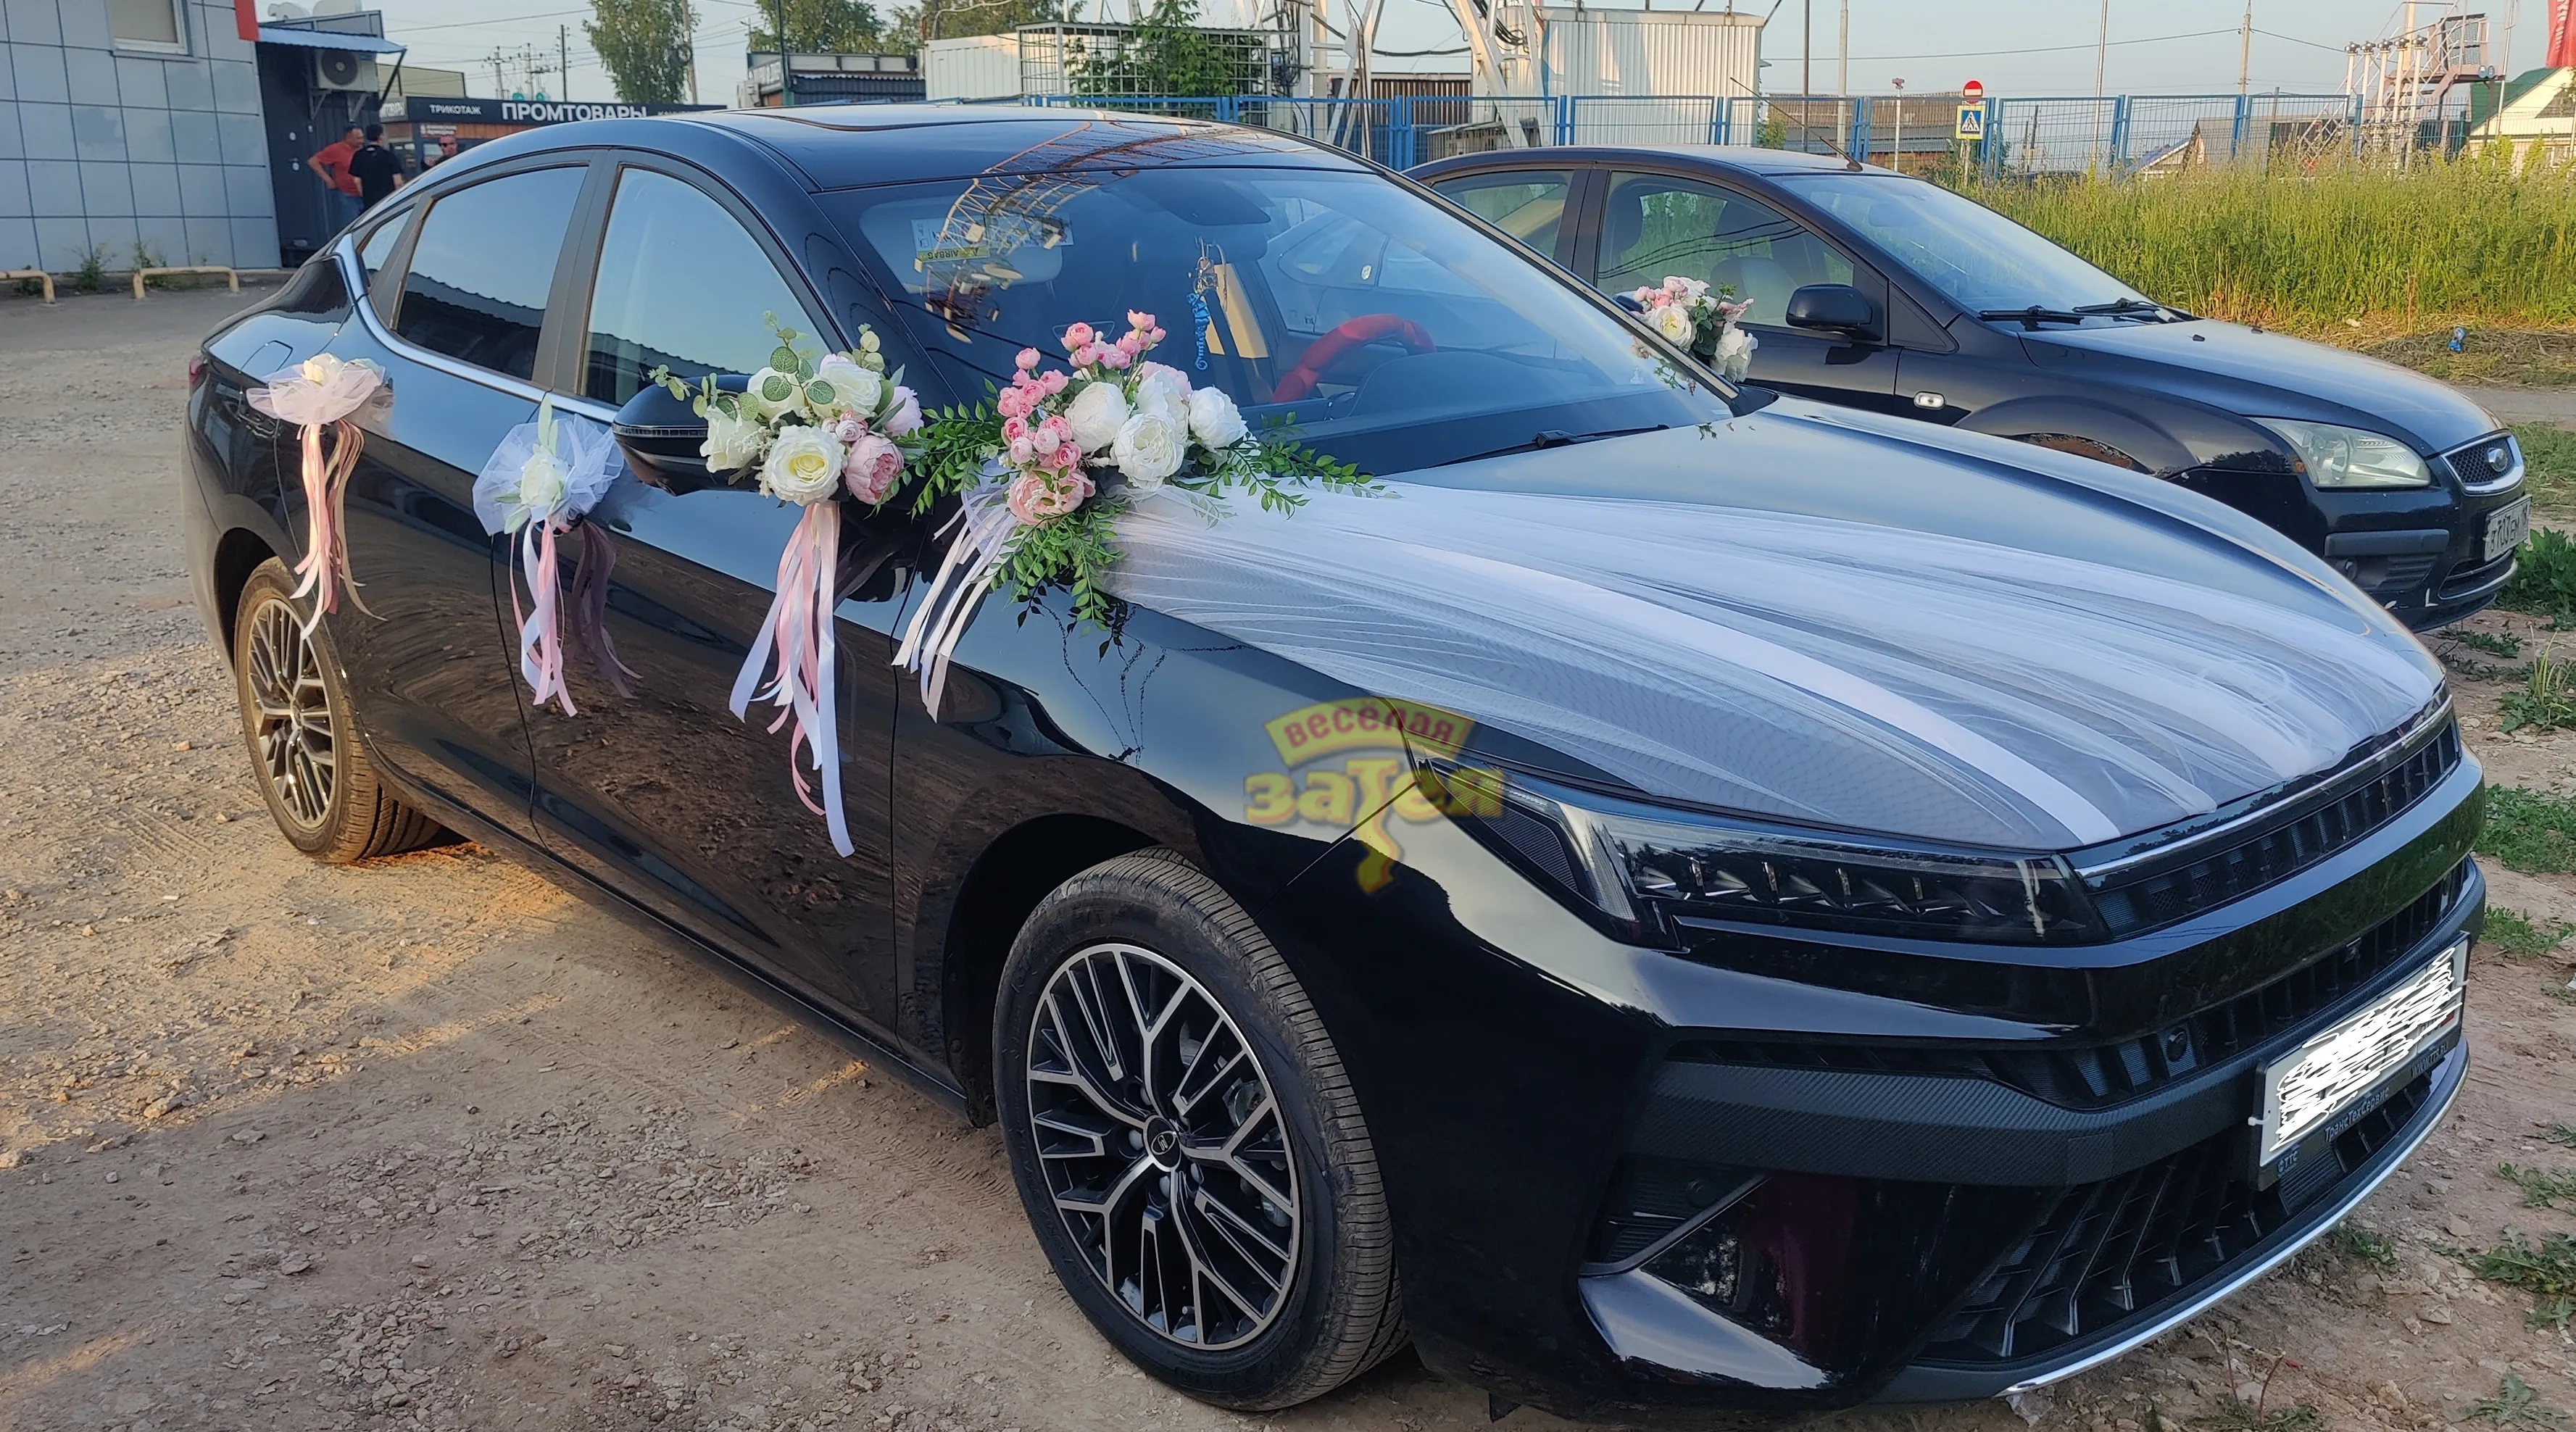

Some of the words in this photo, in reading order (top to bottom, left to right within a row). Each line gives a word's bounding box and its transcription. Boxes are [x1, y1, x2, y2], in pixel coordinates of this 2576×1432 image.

[428, 104, 481, 115] ТРИКОТАЖ
[502, 103, 647, 121] ПРОМТОВАРЫ
[928, 250, 958, 259] AIRBAG
[2324, 1087, 2390, 1143] ТрансТехСервис
